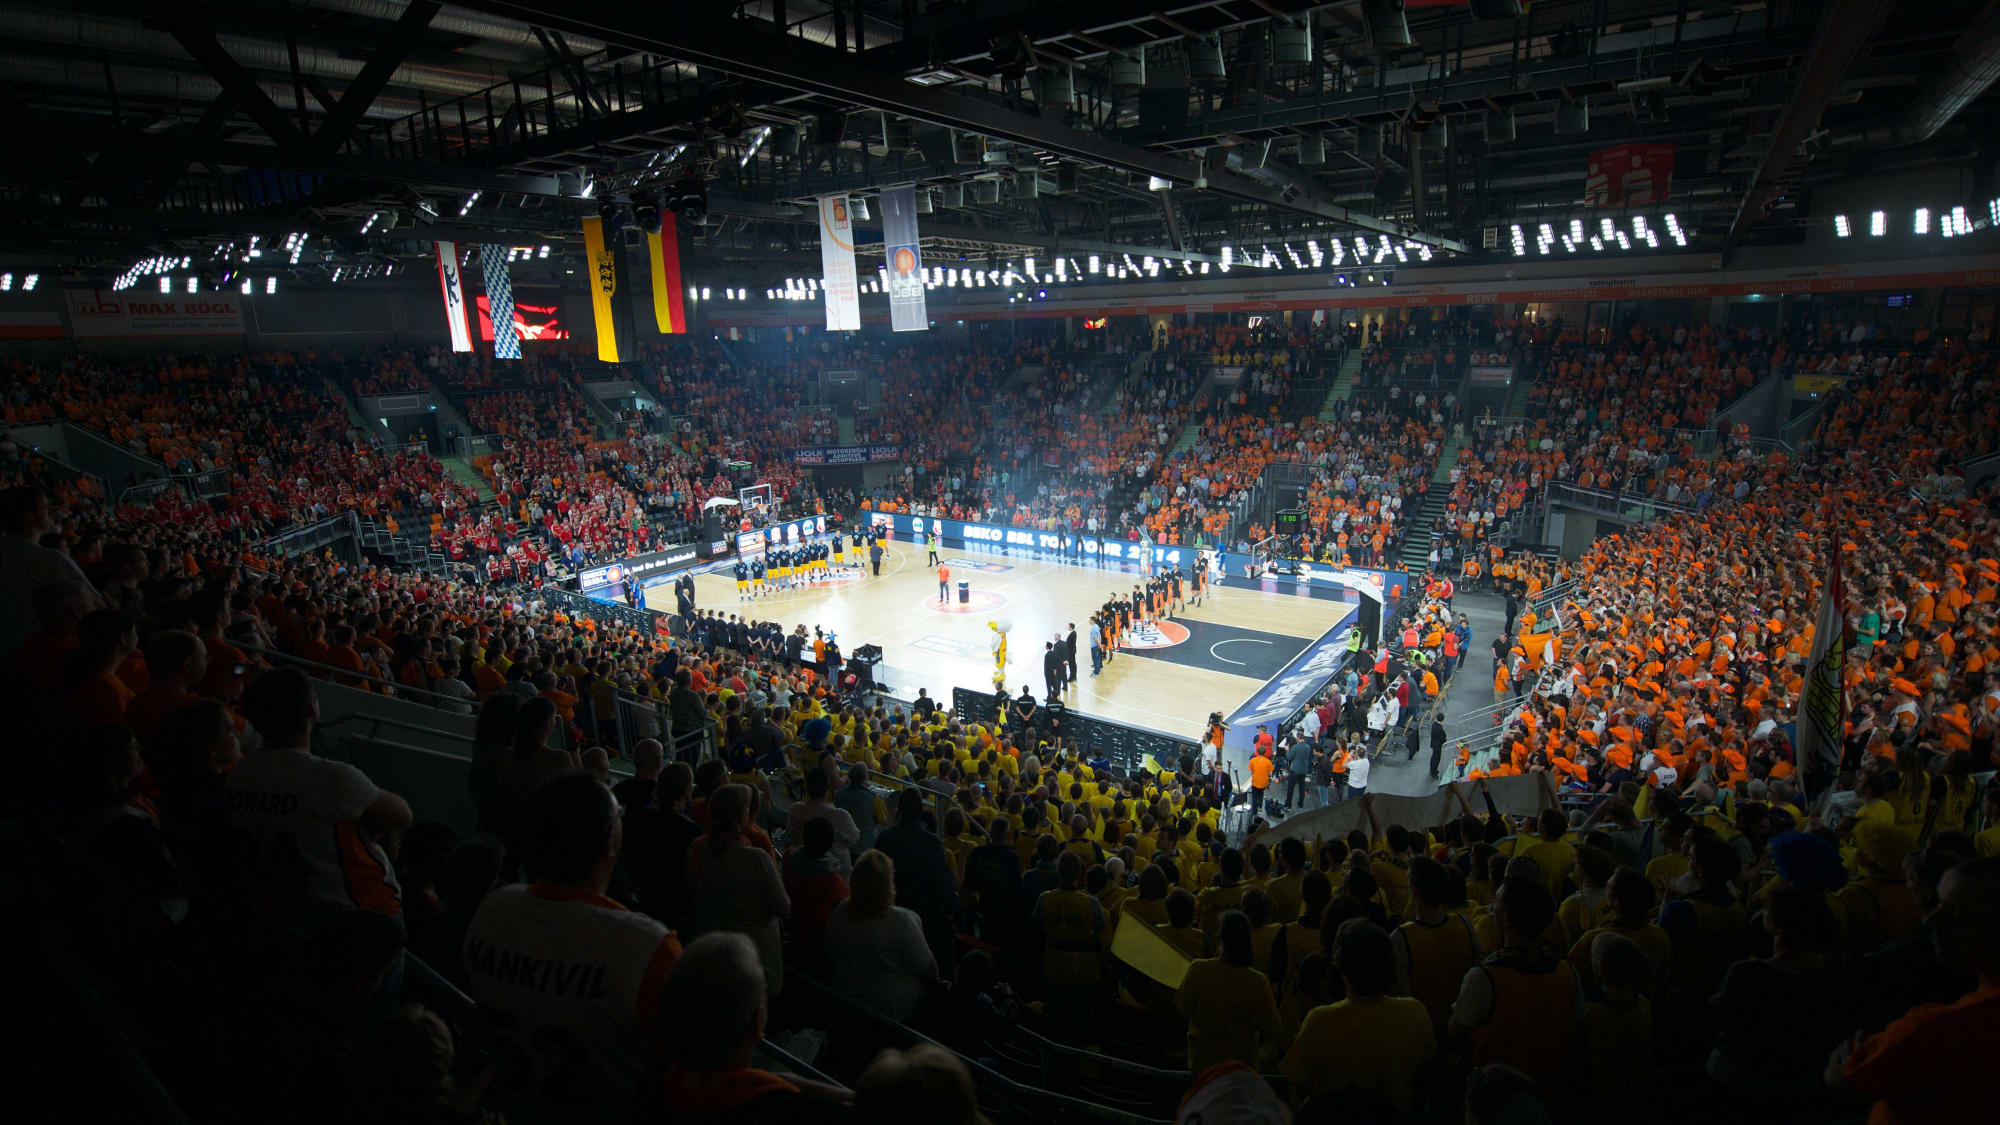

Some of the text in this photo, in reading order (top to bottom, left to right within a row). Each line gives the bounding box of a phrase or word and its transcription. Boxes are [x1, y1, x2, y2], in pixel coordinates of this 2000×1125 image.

[128, 301, 235, 314] MAX BÖGL
[1466, 293, 1498, 304] REWE
[964, 525, 1003, 541] BEKO
[1006, 531, 1034, 546] BBL
[1127, 545, 1180, 564] 214
[467, 936, 606, 998] NANKIVIL
